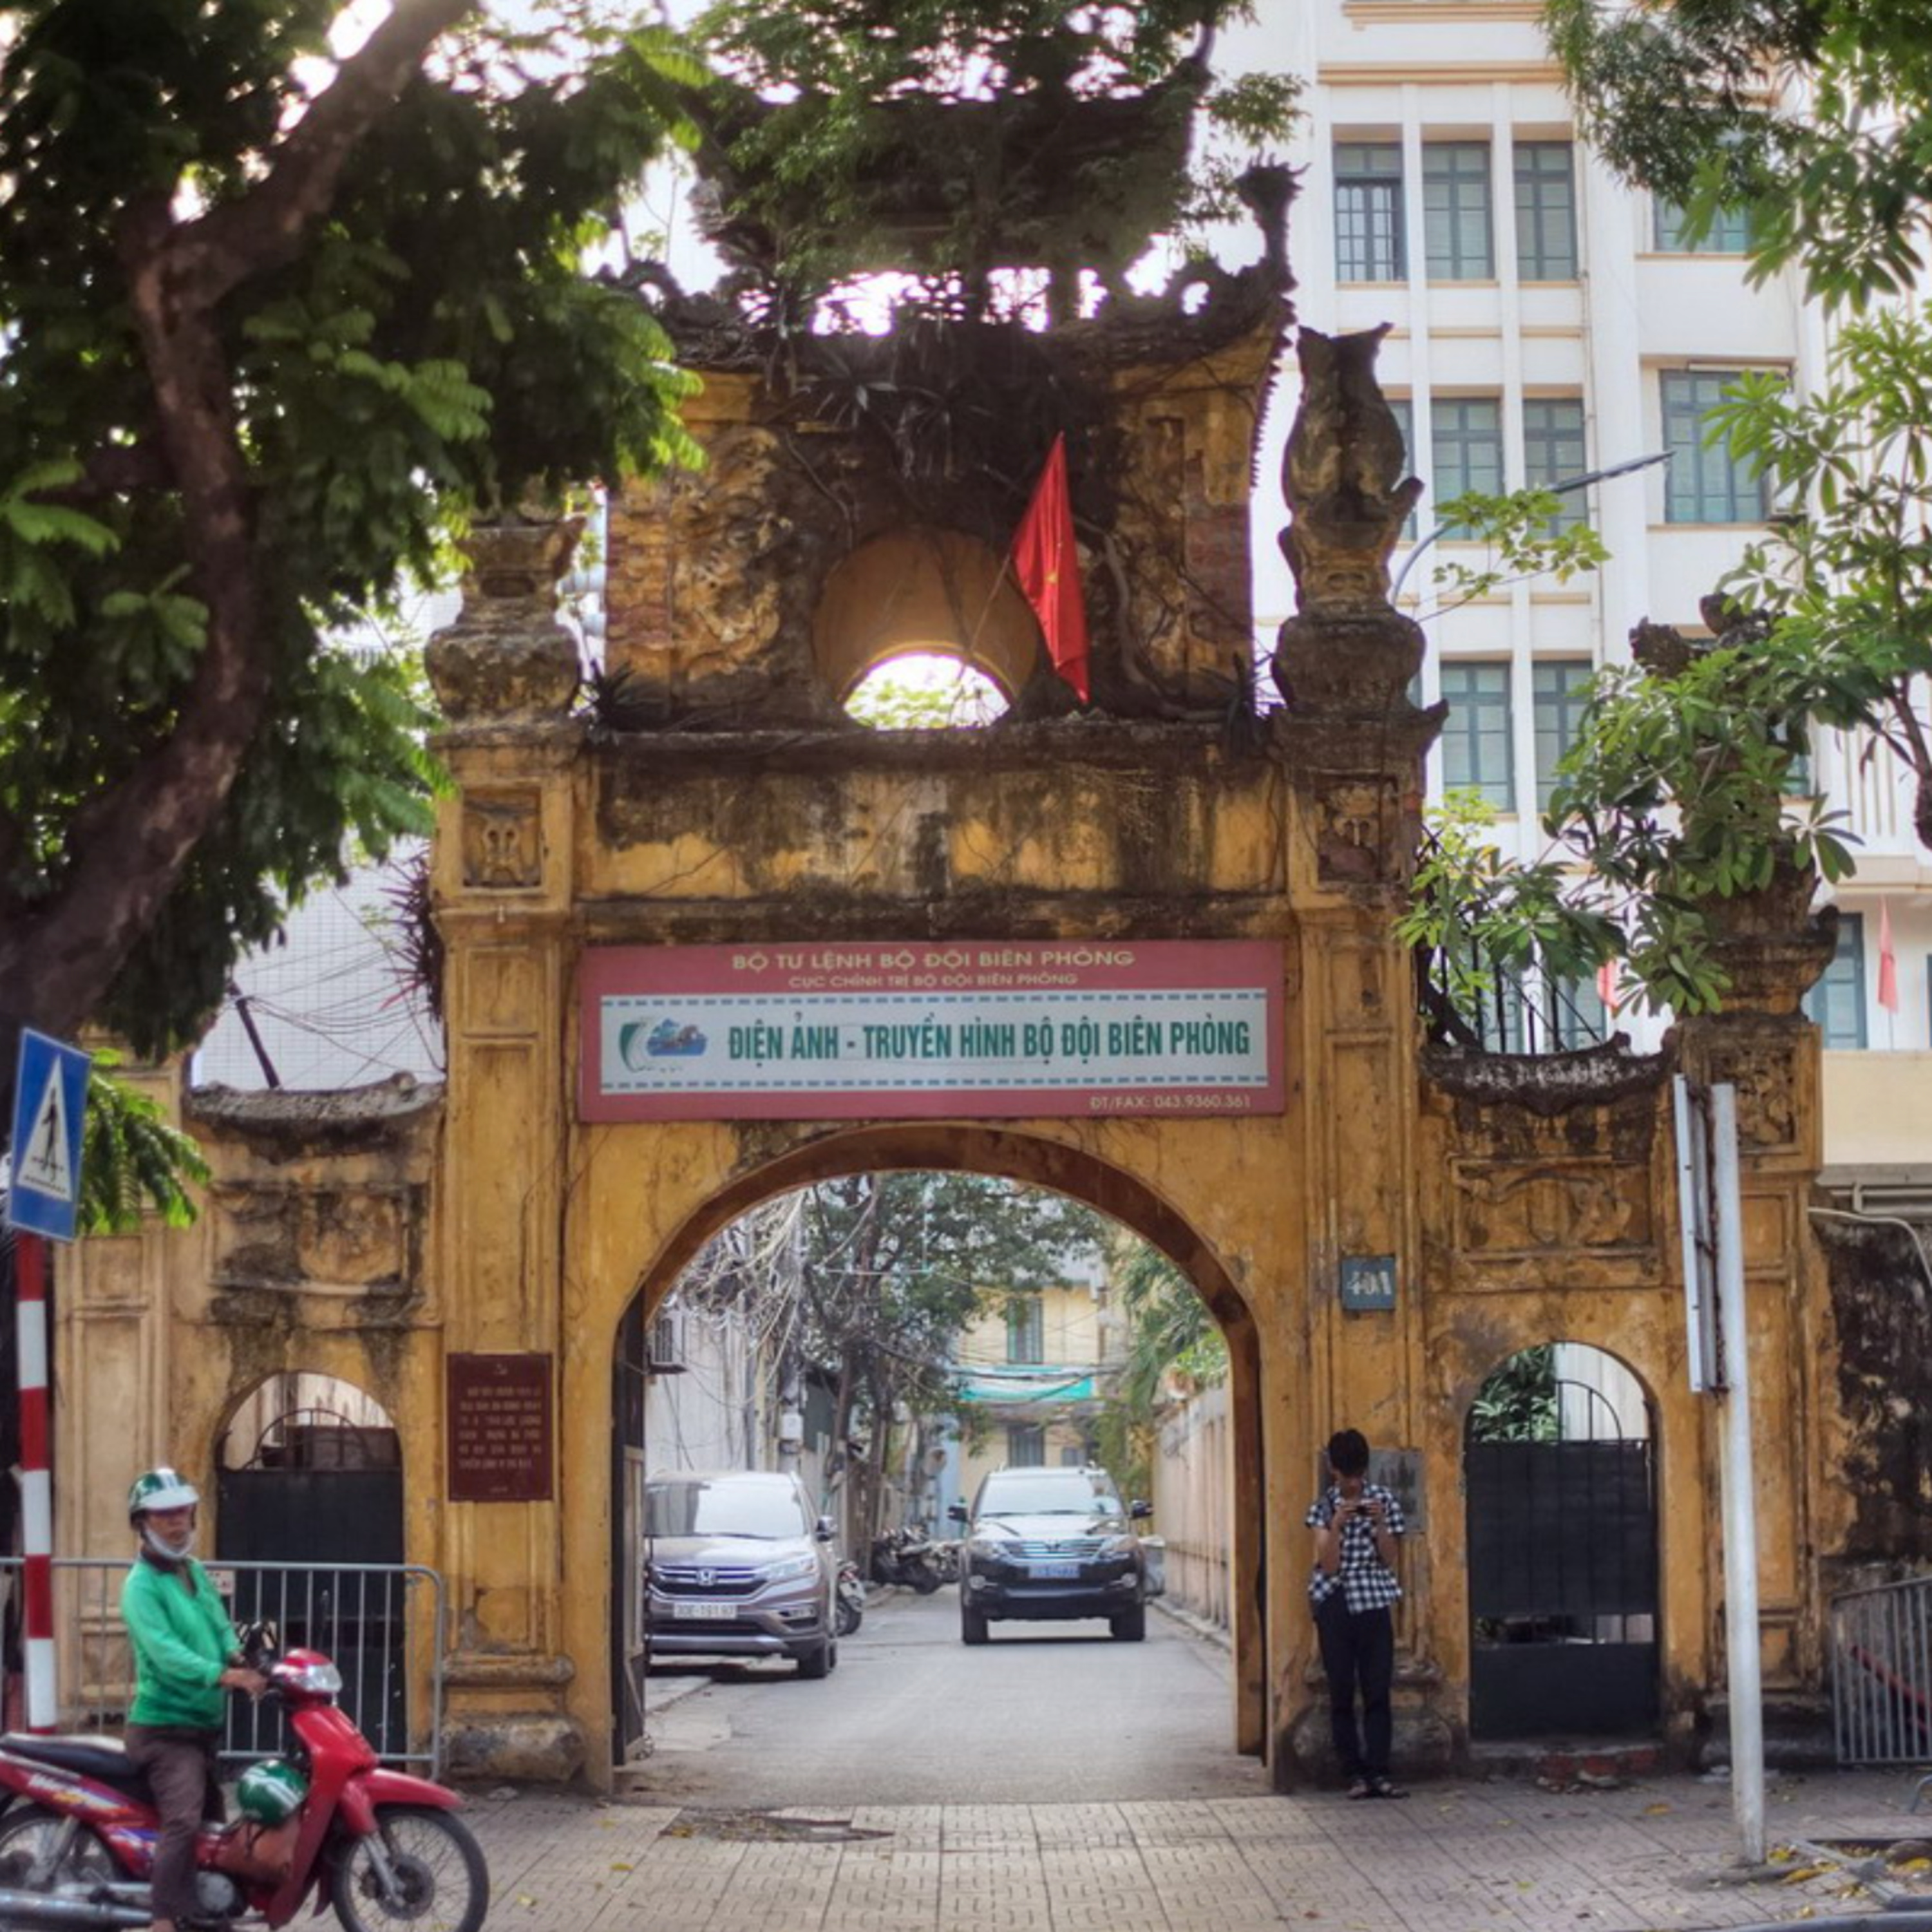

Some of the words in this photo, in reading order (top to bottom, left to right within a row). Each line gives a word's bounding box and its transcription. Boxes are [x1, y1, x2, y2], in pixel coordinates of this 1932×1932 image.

[732, 951, 769, 973] BỘ
[811, 949, 871, 972] LỆNH
[880, 949, 915, 971] BỘ
[923, 949, 970, 969] ĐỘI
[979, 949, 1032, 967] BIÊN
[1040, 946, 1135, 966] PHÒNG
[729, 1019, 782, 1068] ĐIỆN
[791, 1012, 838, 1059] ẢNH
[960, 1017, 1015, 1057] HÌNH
[1023, 1016, 1054, 1065] BỘ
[1061, 1016, 1100, 1064] ĐỘI
[1108, 1015, 1162, 1056] BIÊN
[1170, 1012, 1250, 1055] PHÒNG
